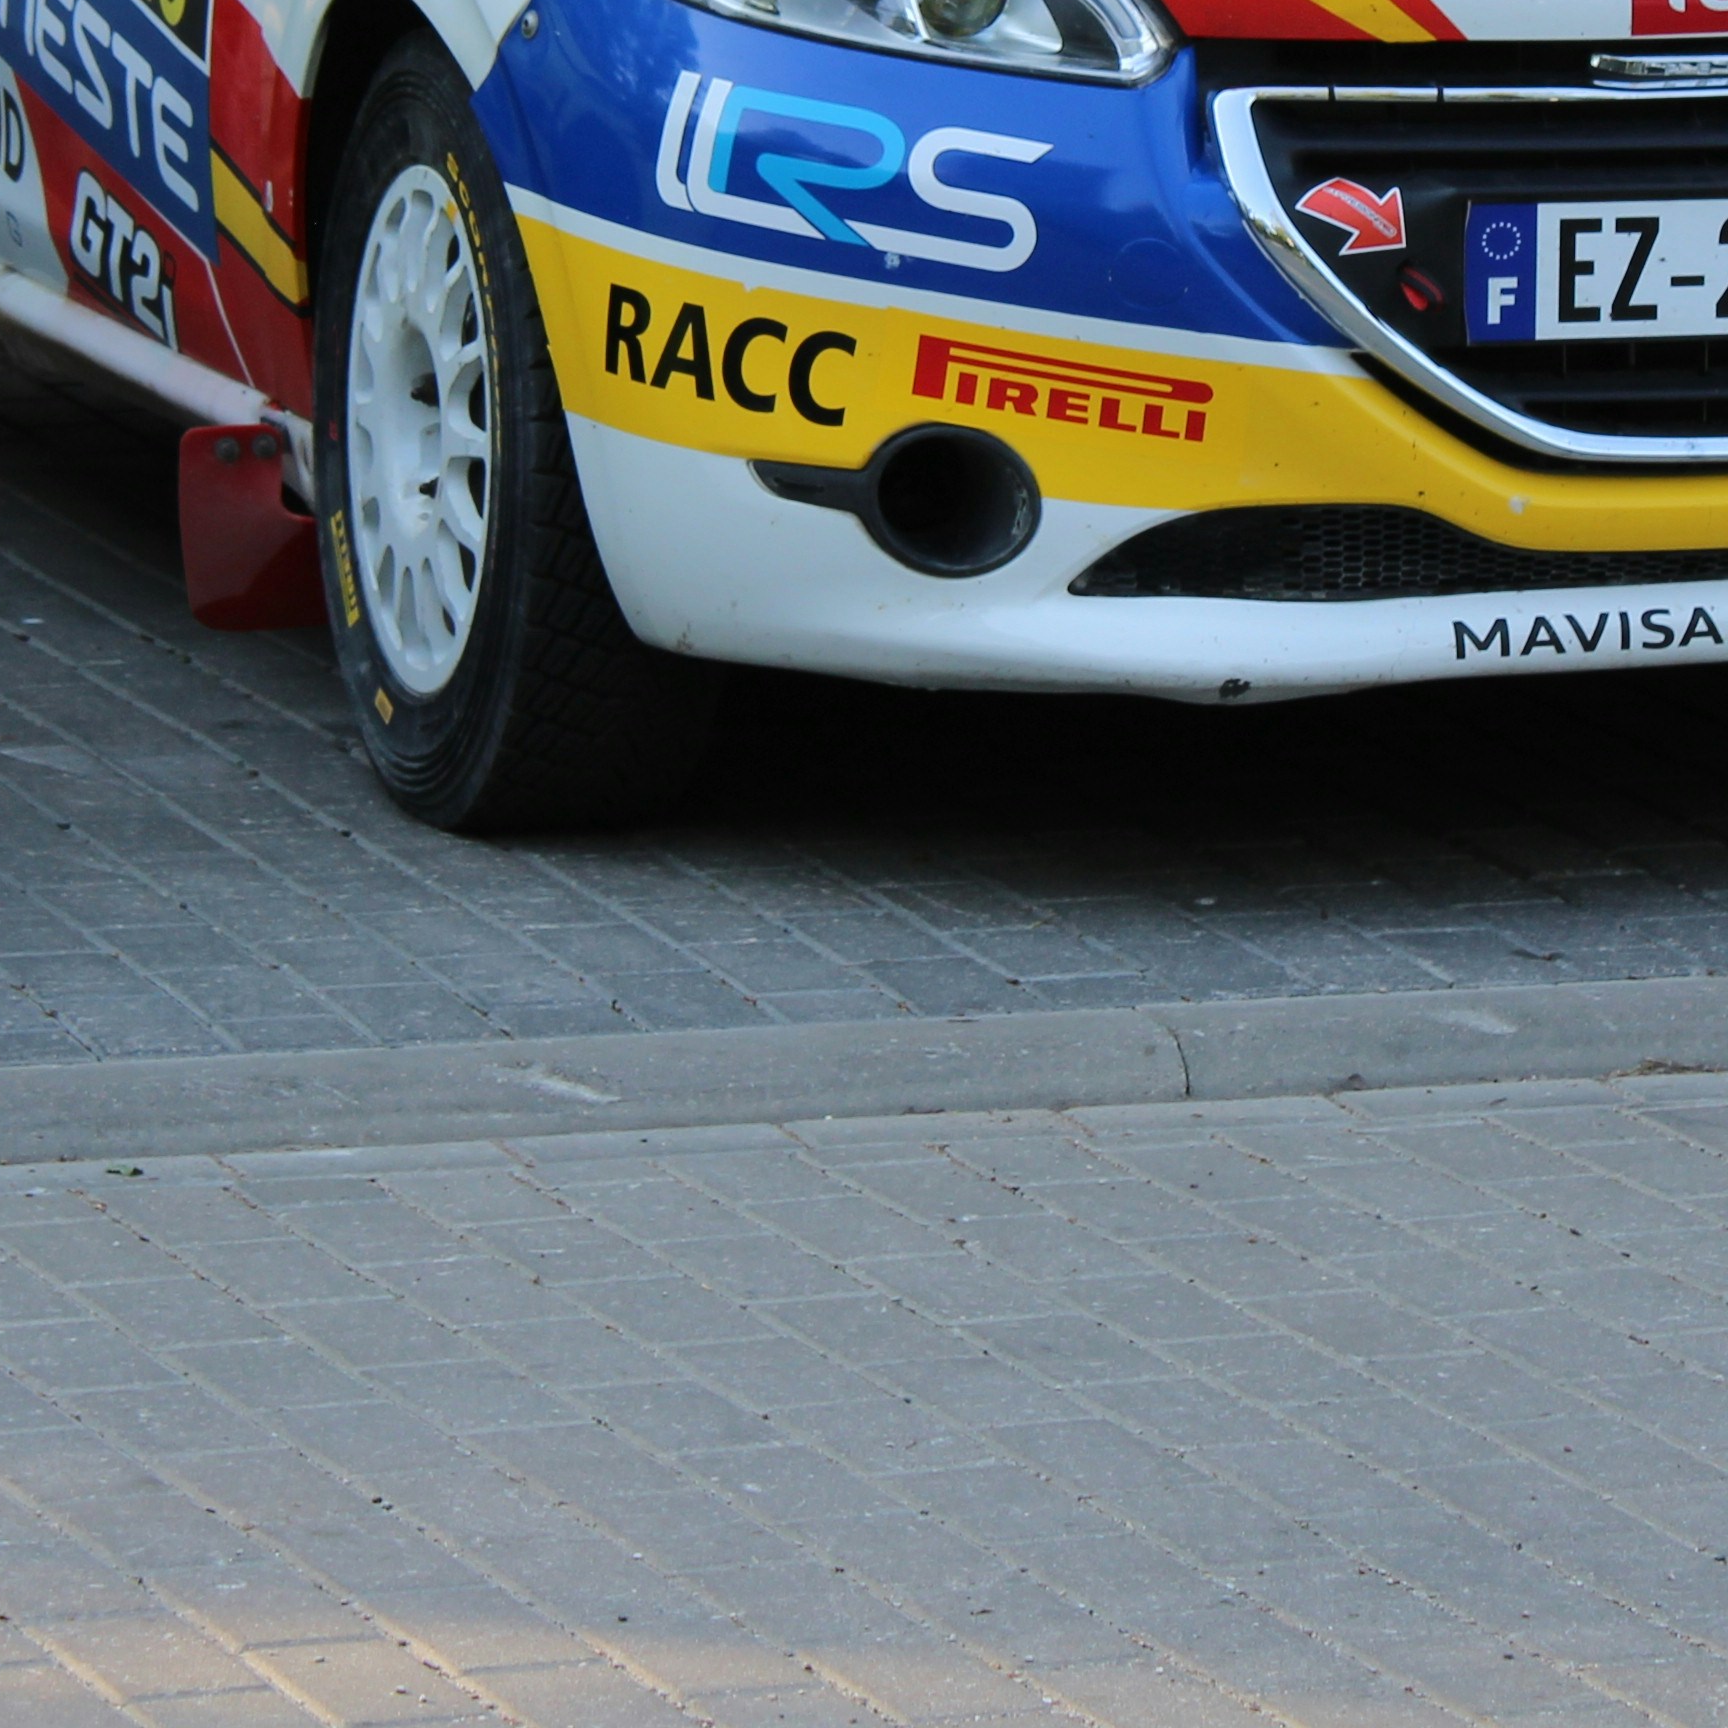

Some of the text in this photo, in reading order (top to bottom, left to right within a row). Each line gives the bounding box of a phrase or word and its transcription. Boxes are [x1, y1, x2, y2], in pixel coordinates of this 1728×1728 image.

[1485, 275, 1519, 325] F
[605, 283, 856, 427] RACC
[912, 334, 1213, 442] PIRELLI
[1452, 606, 1724, 662] MAVISA
